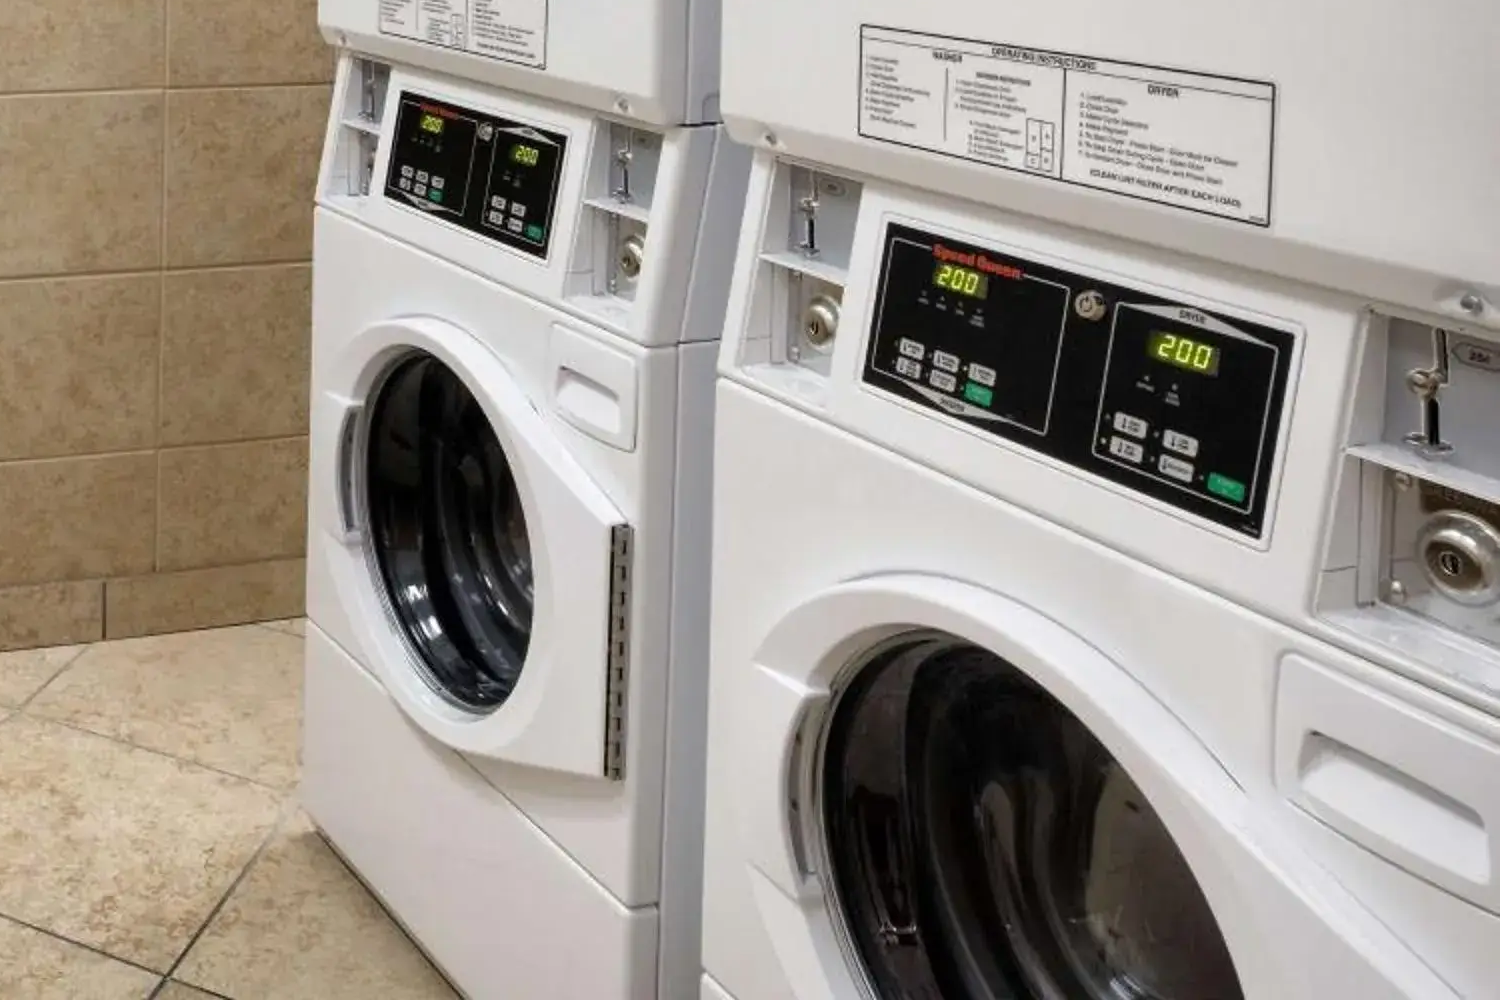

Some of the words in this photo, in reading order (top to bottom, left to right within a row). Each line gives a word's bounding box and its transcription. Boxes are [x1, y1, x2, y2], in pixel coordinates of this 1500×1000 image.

[932, 243, 976, 267] Speed
[936, 264, 979, 296] 200
[1157, 333, 1213, 370] 200
